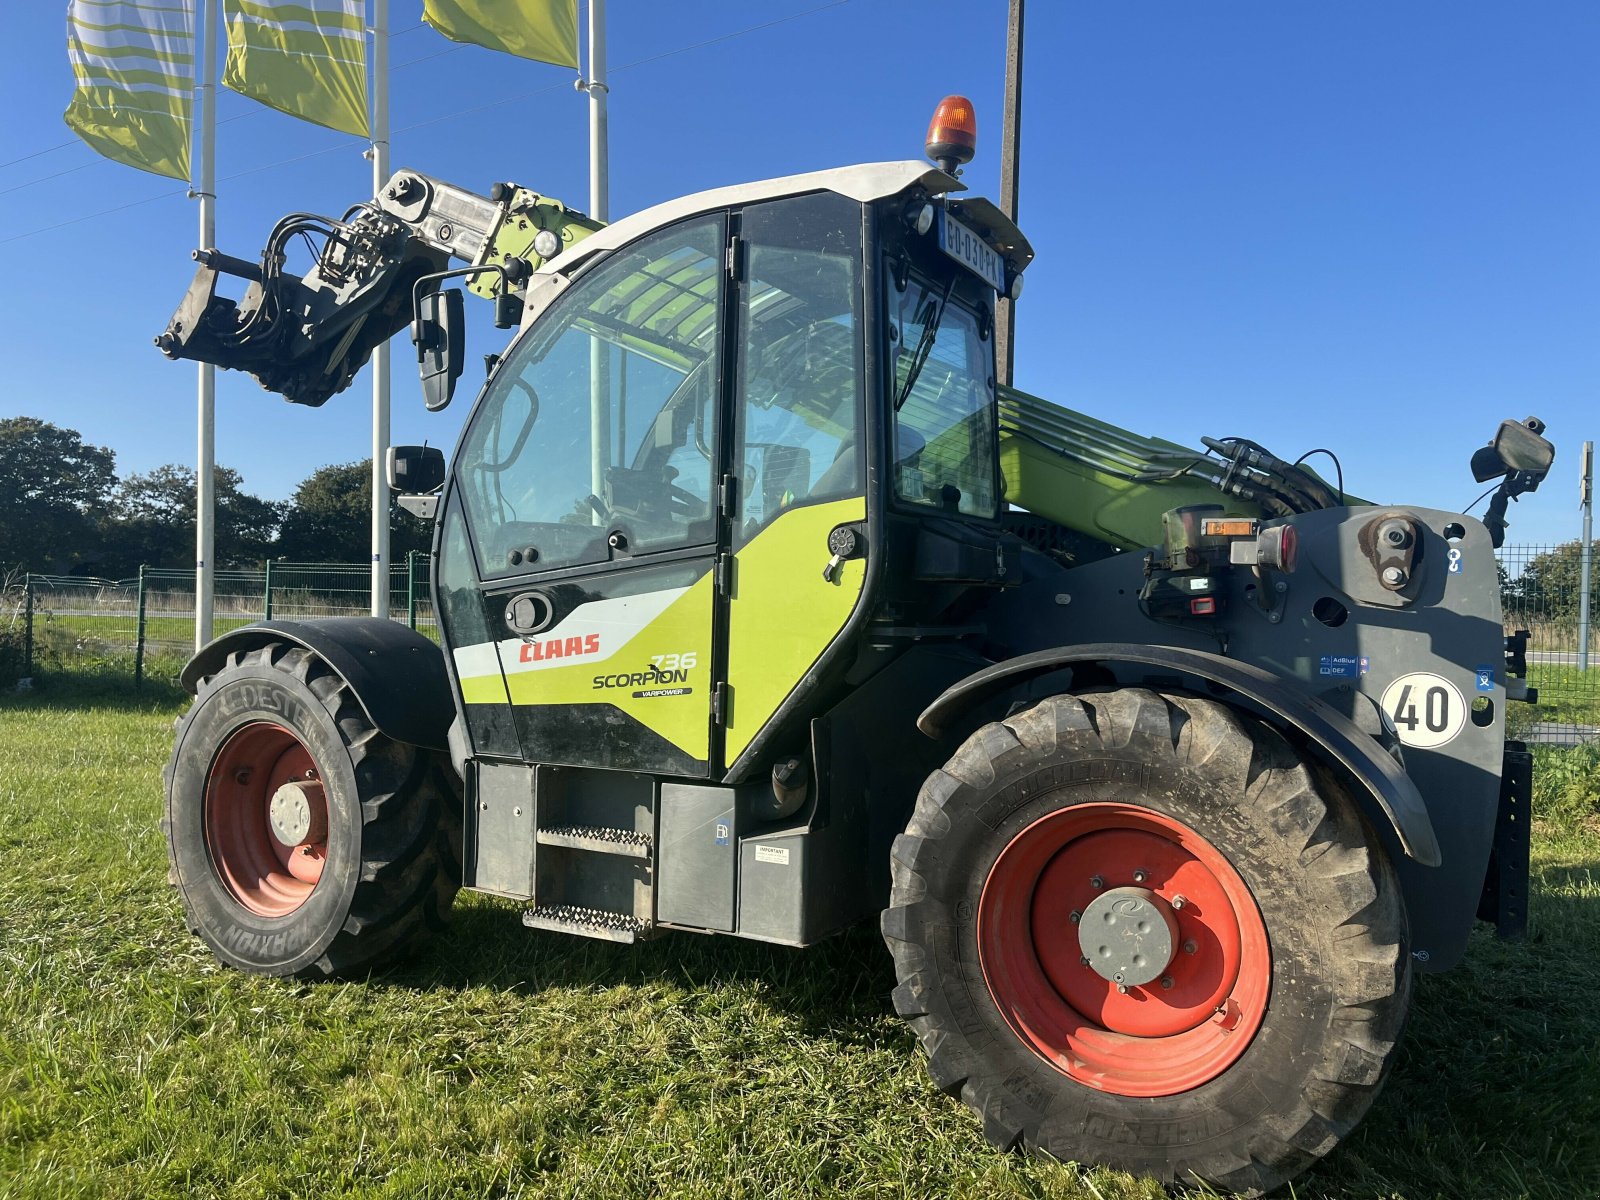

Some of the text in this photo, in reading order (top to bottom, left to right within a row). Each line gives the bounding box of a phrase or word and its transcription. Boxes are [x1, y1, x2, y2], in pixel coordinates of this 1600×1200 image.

[519, 633, 600, 663] CLAAS
[651, 652, 697, 671] 736
[593, 668, 688, 689] SCORPION
[642, 688, 683, 697] VARIPOWER
[1394, 684, 1449, 733] 40
